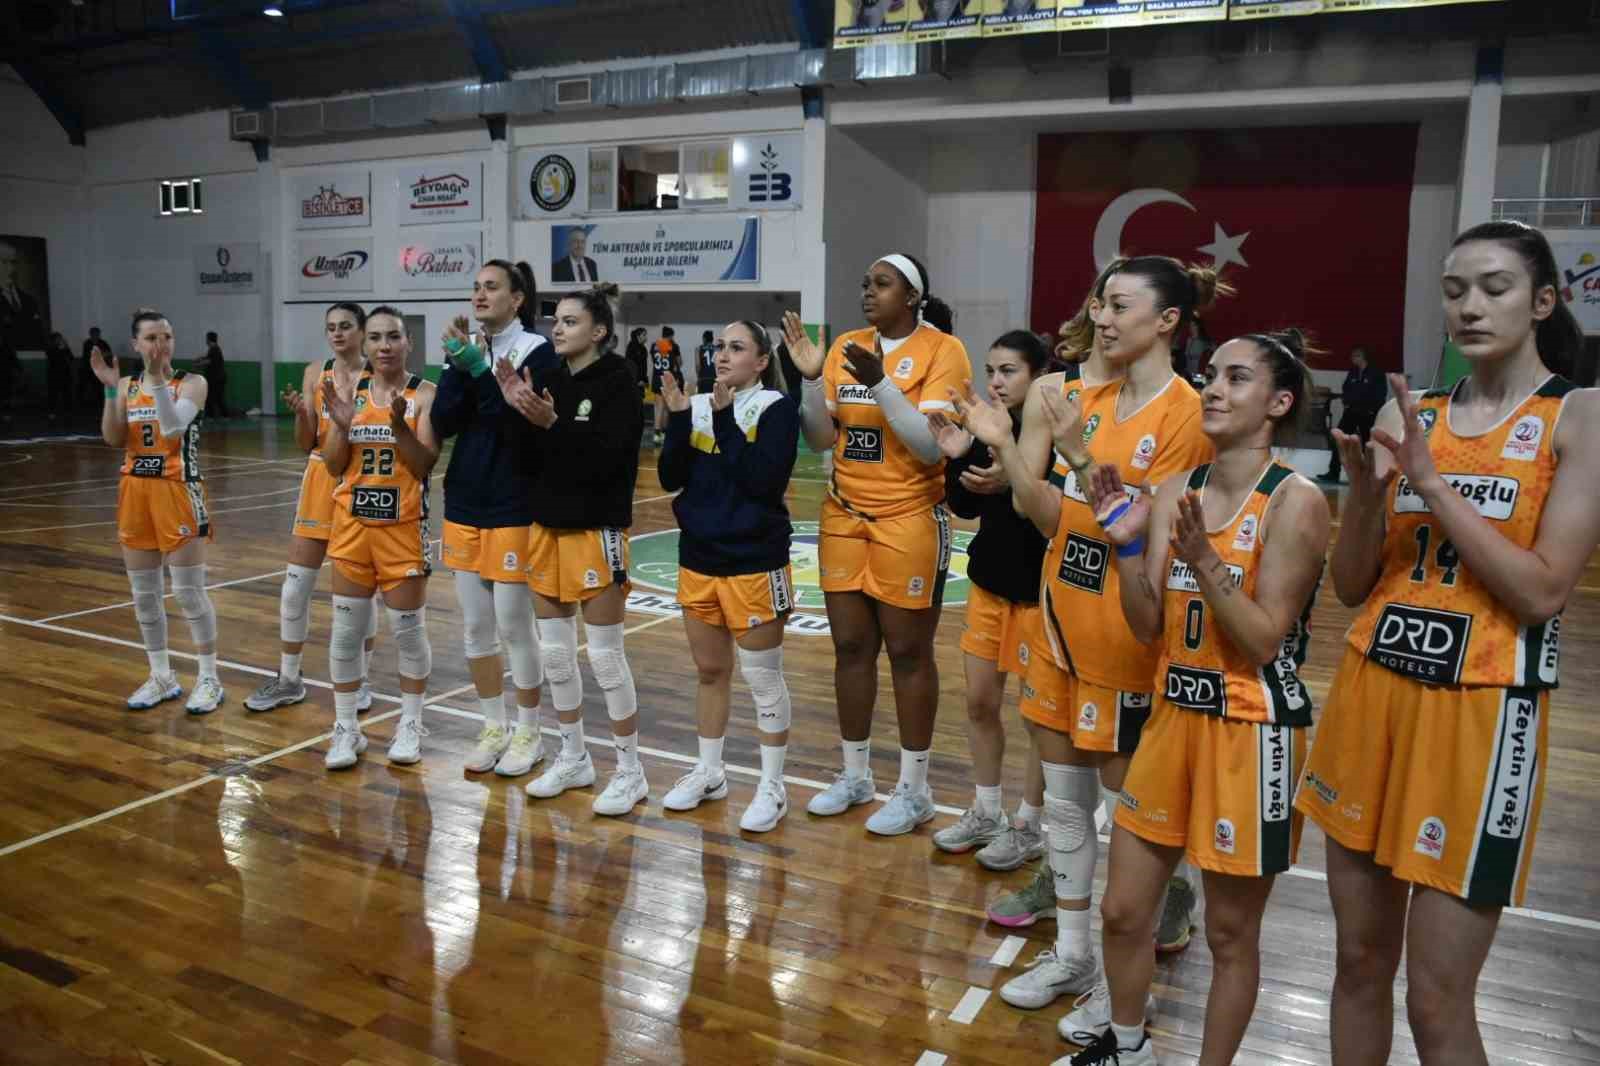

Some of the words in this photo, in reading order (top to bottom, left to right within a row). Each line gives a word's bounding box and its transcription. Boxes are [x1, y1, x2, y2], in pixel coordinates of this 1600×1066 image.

[655, 352, 670, 370] 35
[143, 423, 154, 447] 2
[361, 448, 394, 475] 22
[356, 491, 394, 507] DRD
[1063, 540, 1103, 570] DRD
[1185, 599, 1204, 651] 0
[1379, 614, 1454, 655] DRD
[1380, 655, 1437, 676] HOTELS
[1167, 672, 1214, 702] DRD
[1268, 724, 1284, 772] eytin
[1268, 778, 1285, 819] yağı
[1496, 785, 1519, 835] yağı
